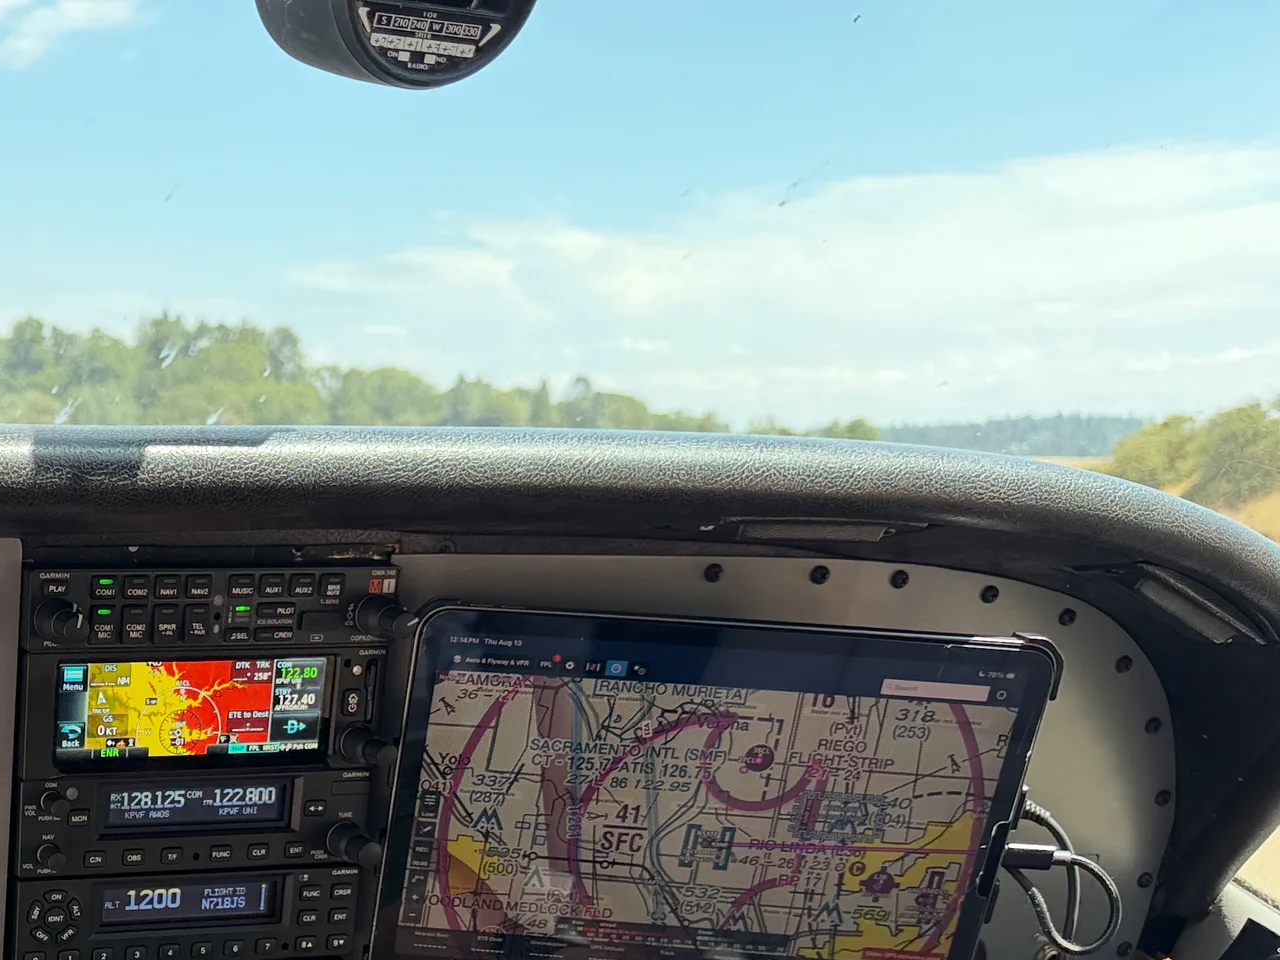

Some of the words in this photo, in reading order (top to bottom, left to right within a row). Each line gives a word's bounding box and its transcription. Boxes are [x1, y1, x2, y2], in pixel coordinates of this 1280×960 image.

[381, 16, 388, 25] S
[394, 17, 409, 28] 210
[411, 20, 426, 30] 240
[432, 22, 441, 31] W
[446, 24, 461, 34] 300
[463, 26, 478, 36] 330
[49, 585, 66, 593] PLAY
[96, 588, 115, 596] COM1
[127, 588, 147, 596] COM2
[295, 586, 312, 594] AUX2
[281, 667, 318, 679] 122.80
[63, 683, 83, 691] Menu
[600, 679, 666, 695] RANCHO
[671, 683, 742, 700] MURIETA
[278, 693, 316, 706] 127.40
[892, 724, 930, 740] (253)
[62, 739, 80, 748] Back
[529, 738, 641, 759] SACRAMENTO
[645, 744, 680, 760] INTL
[817, 738, 867, 753] RIEGO
[100, 748, 119, 757] ENR
[121, 790, 185, 810] 128.125
[213, 786, 276, 806] 122.800
[219, 806, 239, 816] KPVF
[242, 805, 257, 814] UNI
[71, 814, 88, 823] MON
[600, 831, 643, 853] SFC
[125, 887, 181, 911] 1200
[202, 896, 246, 910] N718JS
